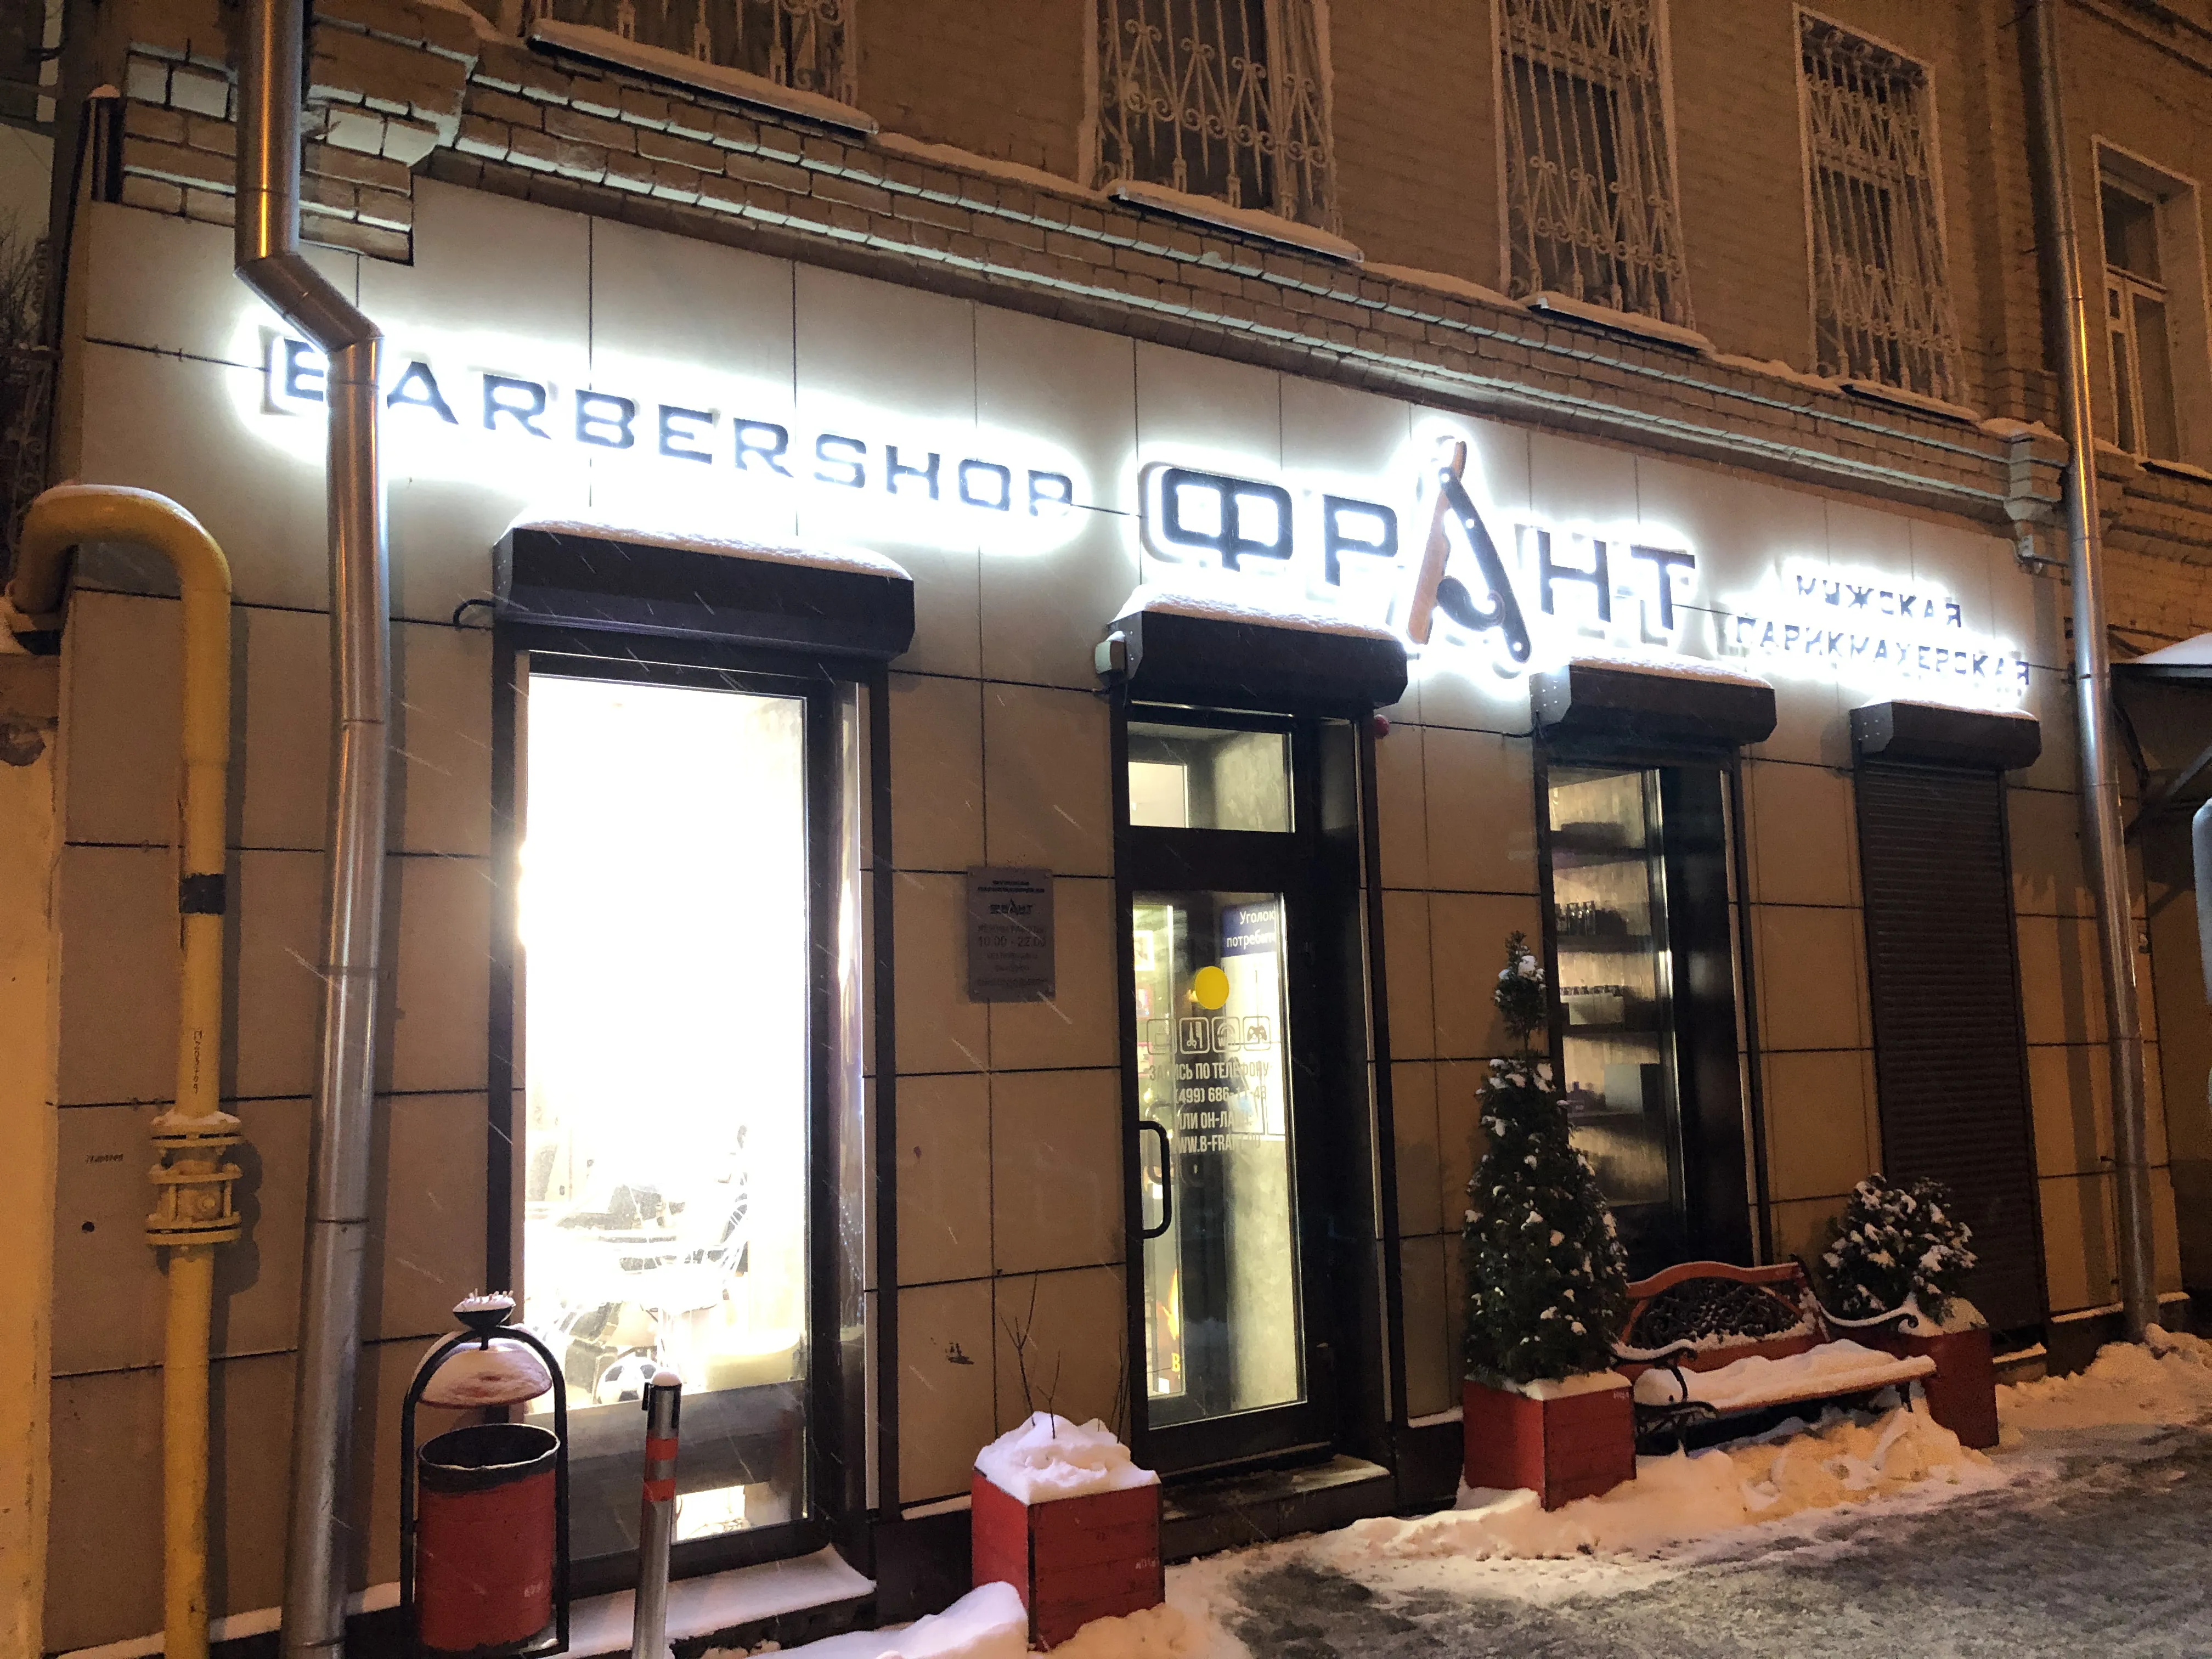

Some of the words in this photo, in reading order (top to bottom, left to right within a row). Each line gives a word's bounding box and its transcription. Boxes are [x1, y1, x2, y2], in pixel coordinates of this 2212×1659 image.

[284, 338, 1073, 517] BARBERSHOP
[1161, 441, 1696, 663] ФРАНТ
[1195, 1062, 1210, 1080] ПО
